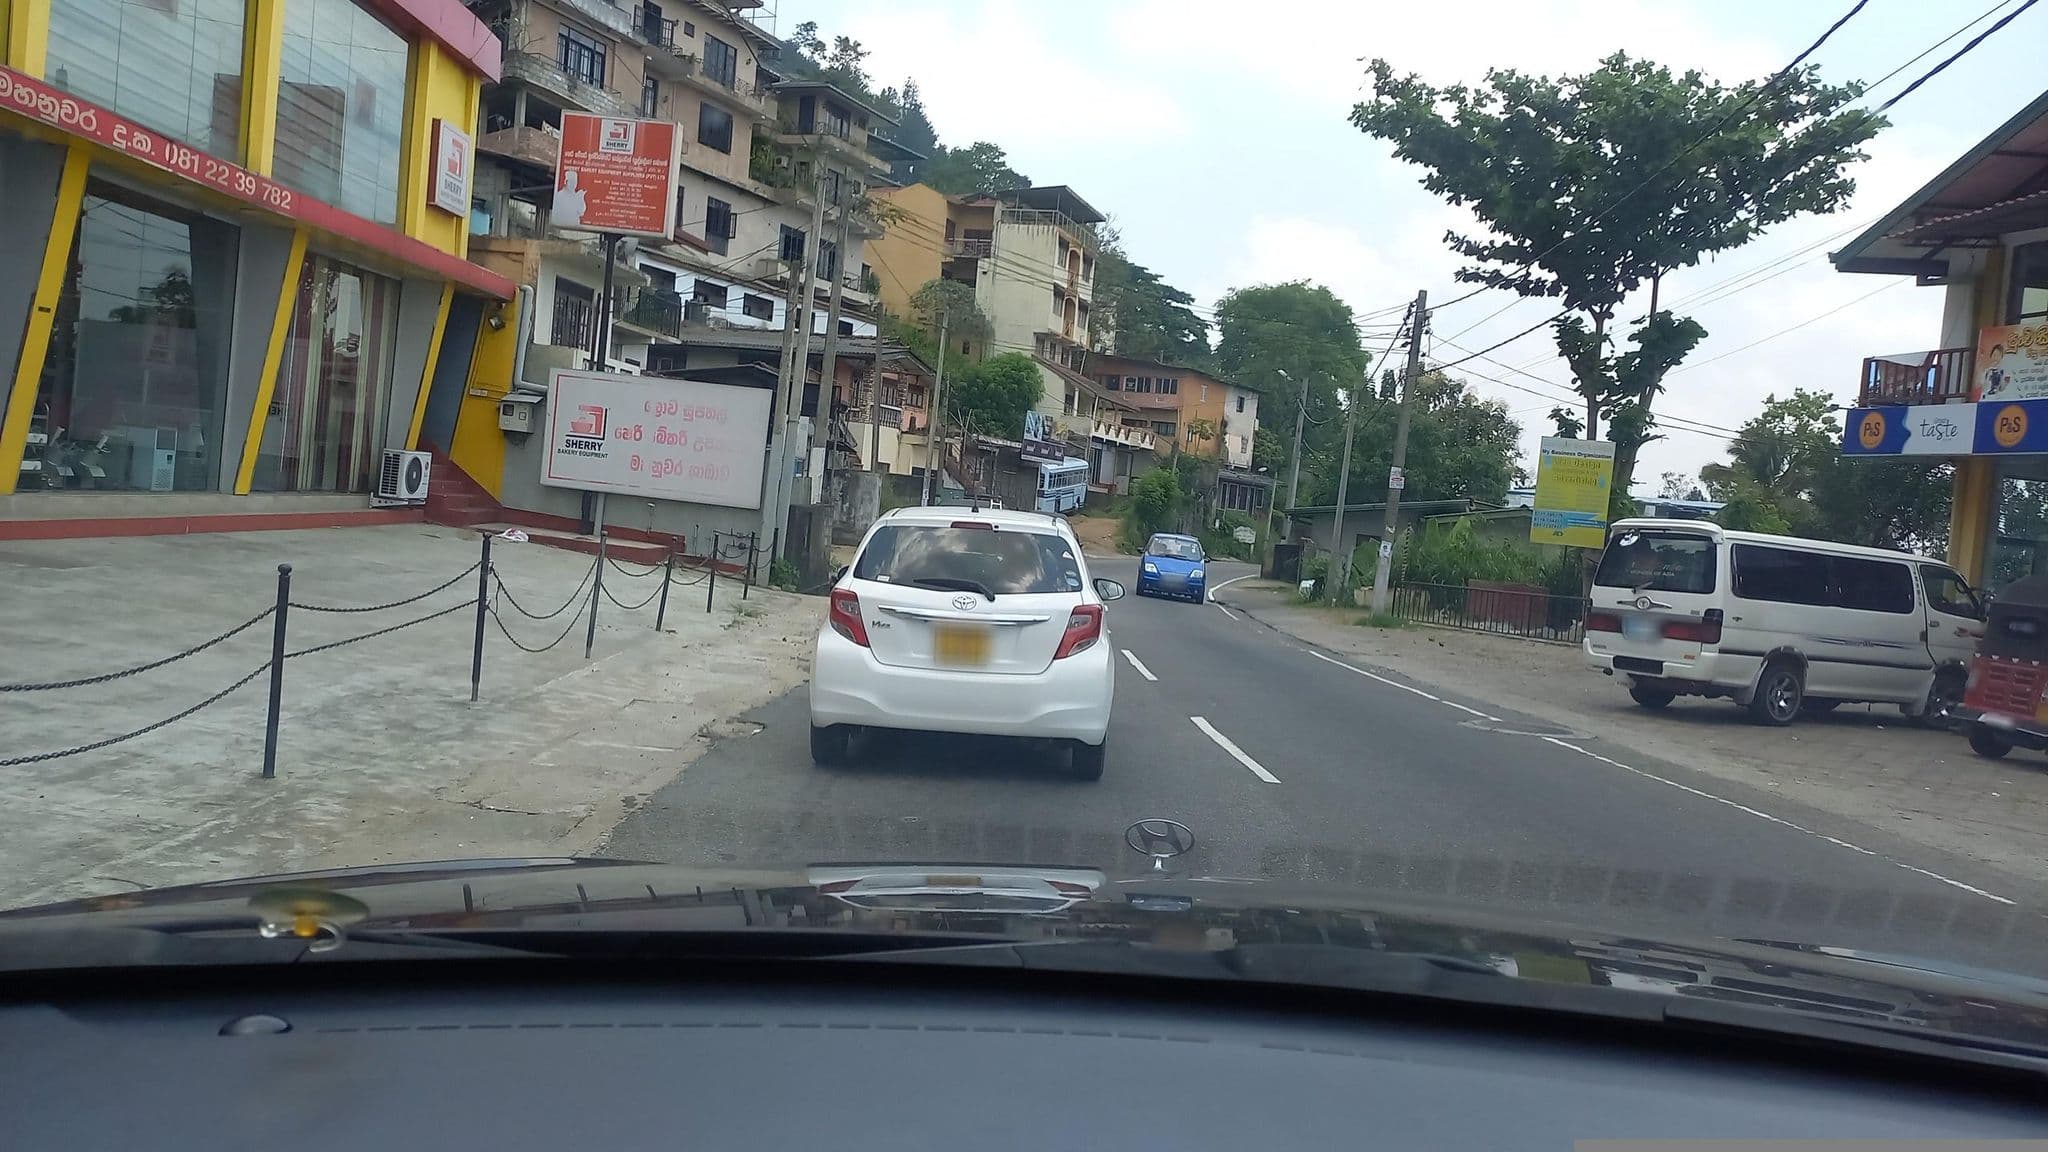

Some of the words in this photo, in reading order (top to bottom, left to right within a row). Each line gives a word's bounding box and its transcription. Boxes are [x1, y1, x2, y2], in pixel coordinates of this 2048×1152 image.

[164, 142, 200, 174] 081
[204, 160, 230, 187] 22
[234, 171, 256, 196] 39
[262, 183, 292, 210] 782
[1919, 418, 1959, 441] taste
[557, 448, 578, 456] BAKERY
[578, 449, 609, 459] EQUIPMENT
[565, 439, 603, 452] SHERRY
